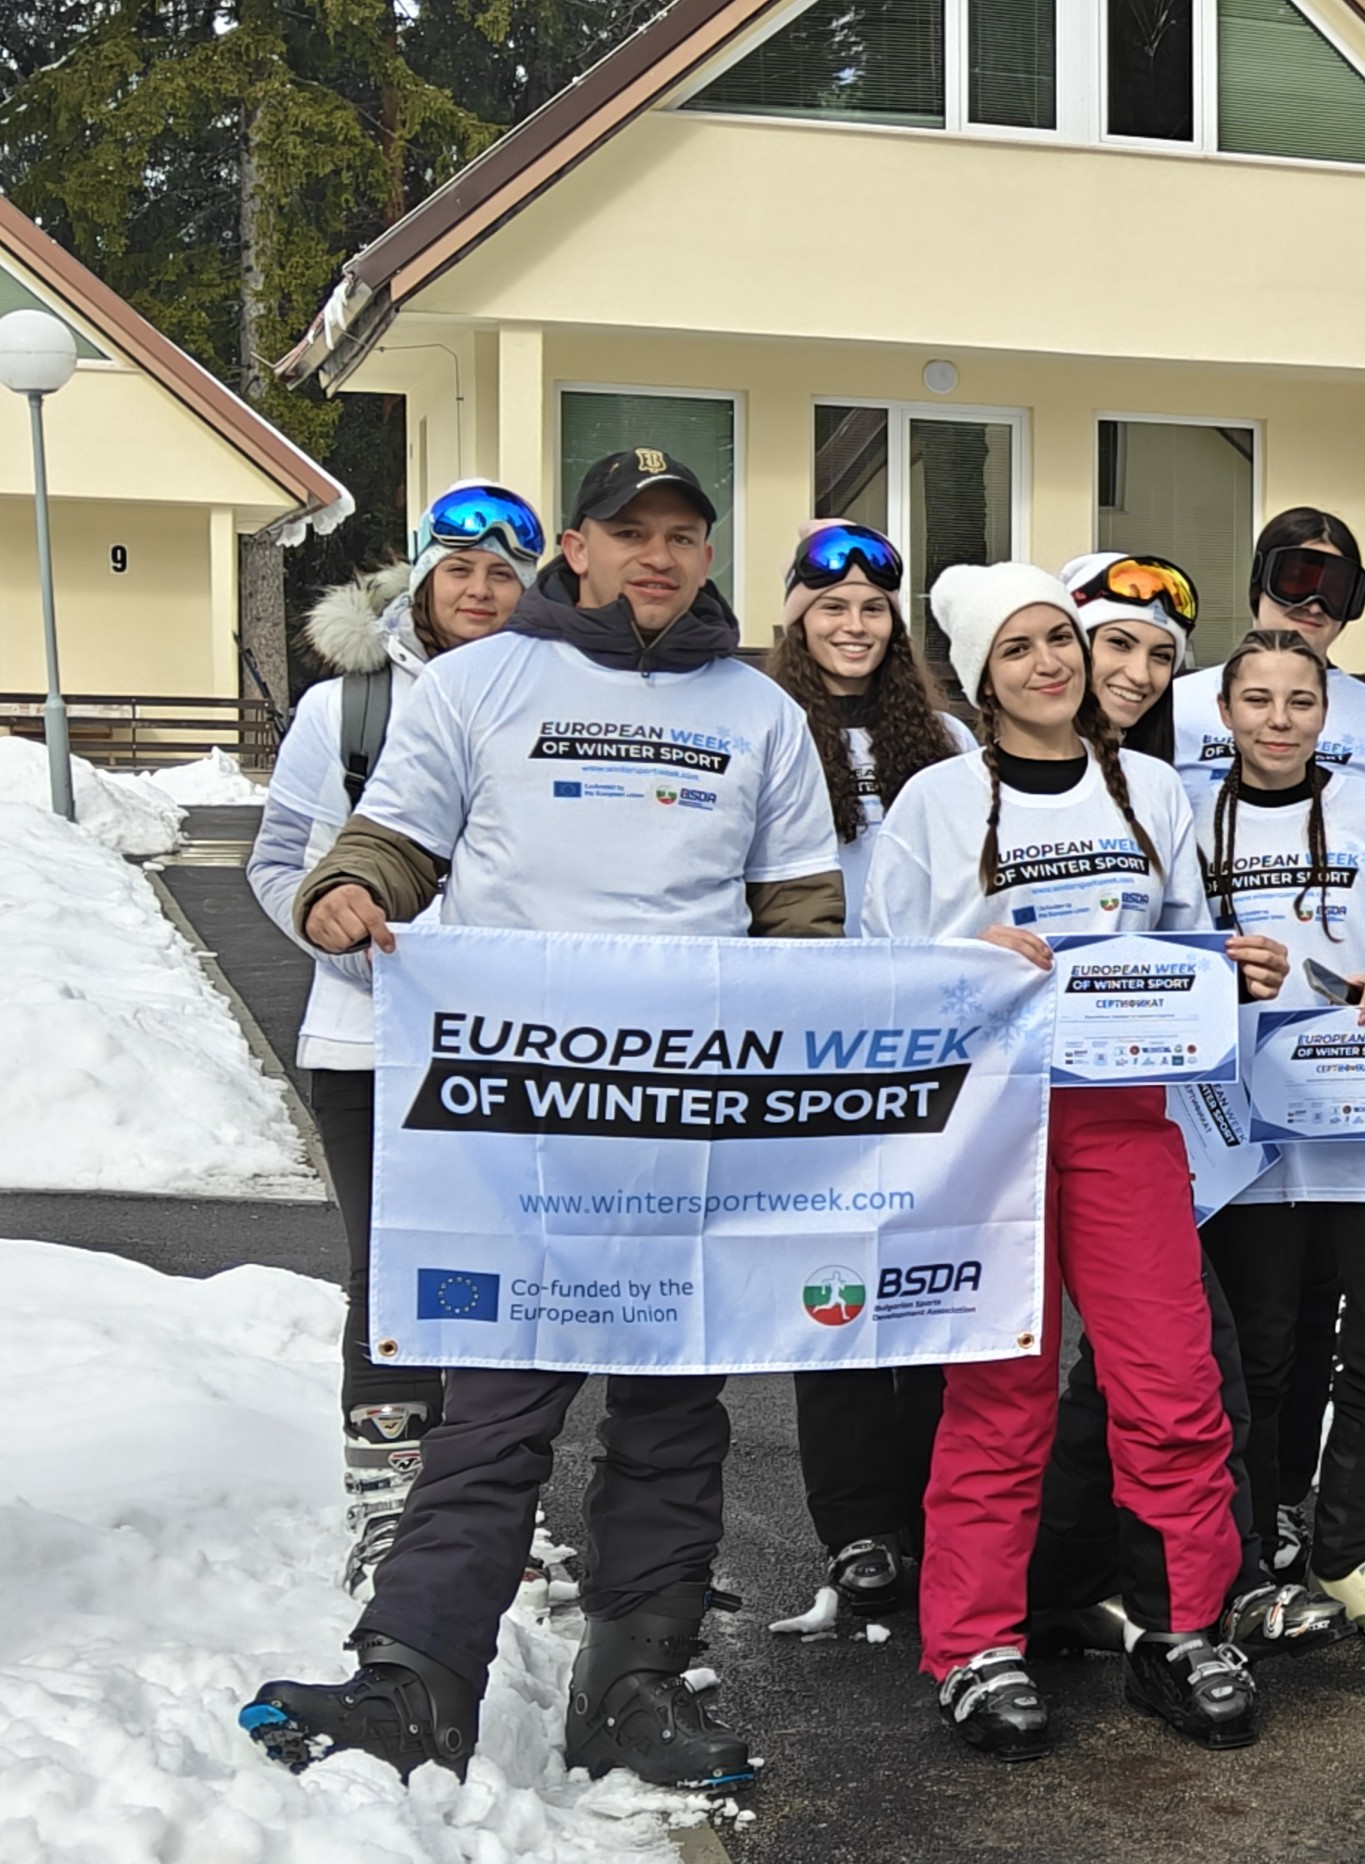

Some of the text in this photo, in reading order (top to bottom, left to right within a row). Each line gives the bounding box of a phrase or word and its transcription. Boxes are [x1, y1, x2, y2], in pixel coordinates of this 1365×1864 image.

[111, 545, 127, 572] 9
[540, 721, 732, 752] EUROPEAN WEEK
[542, 741, 722, 769] OF WINTER SPORT
[1205, 746, 1224, 757] OF
[998, 838, 1142, 865] UROPEAN WEE
[993, 856, 1146, 886] OF WINTER SPORT
[1231, 872, 1292, 888] WINTER
[1297, 871, 1350, 884] SORT
[1071, 963, 1196, 975] EUROPEAN WEEK
[1072, 978, 1189, 990] OF WINTER SPORT
[432, 1011, 981, 1069] EUROPEAN WEEK
[1298, 1033, 1365, 1044] EUROPEAN
[1298, 1049, 1313, 1057] OF
[1316, 1048, 1360, 1056] WINTER
[440, 1076, 939, 1126] OF WINTER SPORT
[1213, 1110, 1234, 1145] SPORT
[518, 1187, 914, 1216] www.wintersportweek.com
[510, 1278, 693, 1303] Co-funded by the
[877, 1261, 982, 1300] BSDA
[509, 1303, 678, 1326] European Union
[872, 1307, 976, 1321] Development Association
[874, 1300, 942, 1312] Bulgarian Sports
